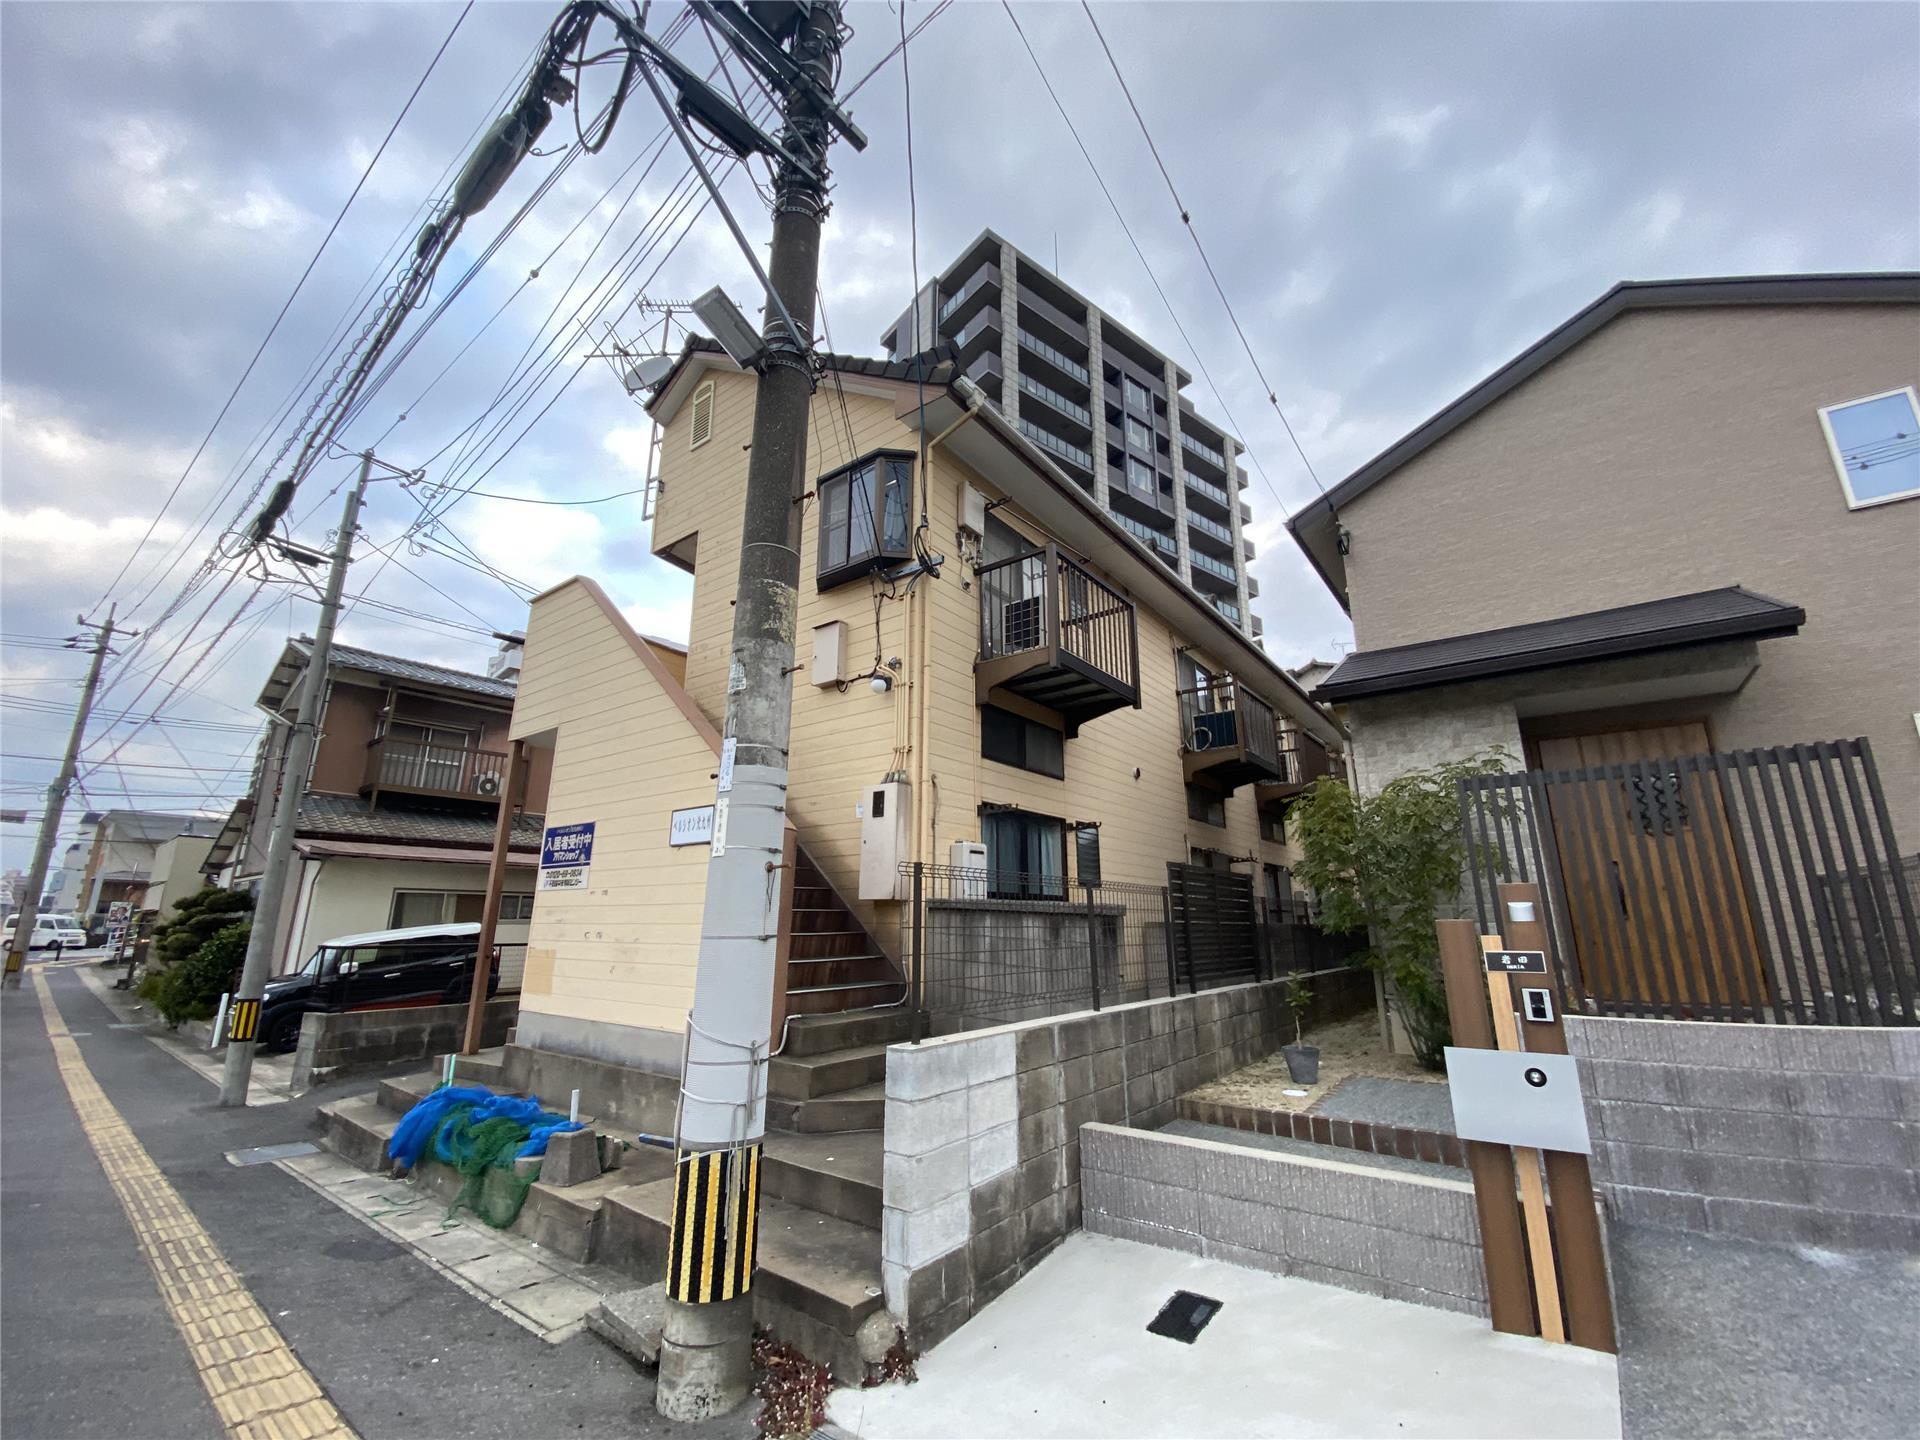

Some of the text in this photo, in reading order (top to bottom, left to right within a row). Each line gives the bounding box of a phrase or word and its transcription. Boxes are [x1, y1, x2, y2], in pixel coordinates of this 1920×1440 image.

[545, 832, 592, 851] 入居者受付中
